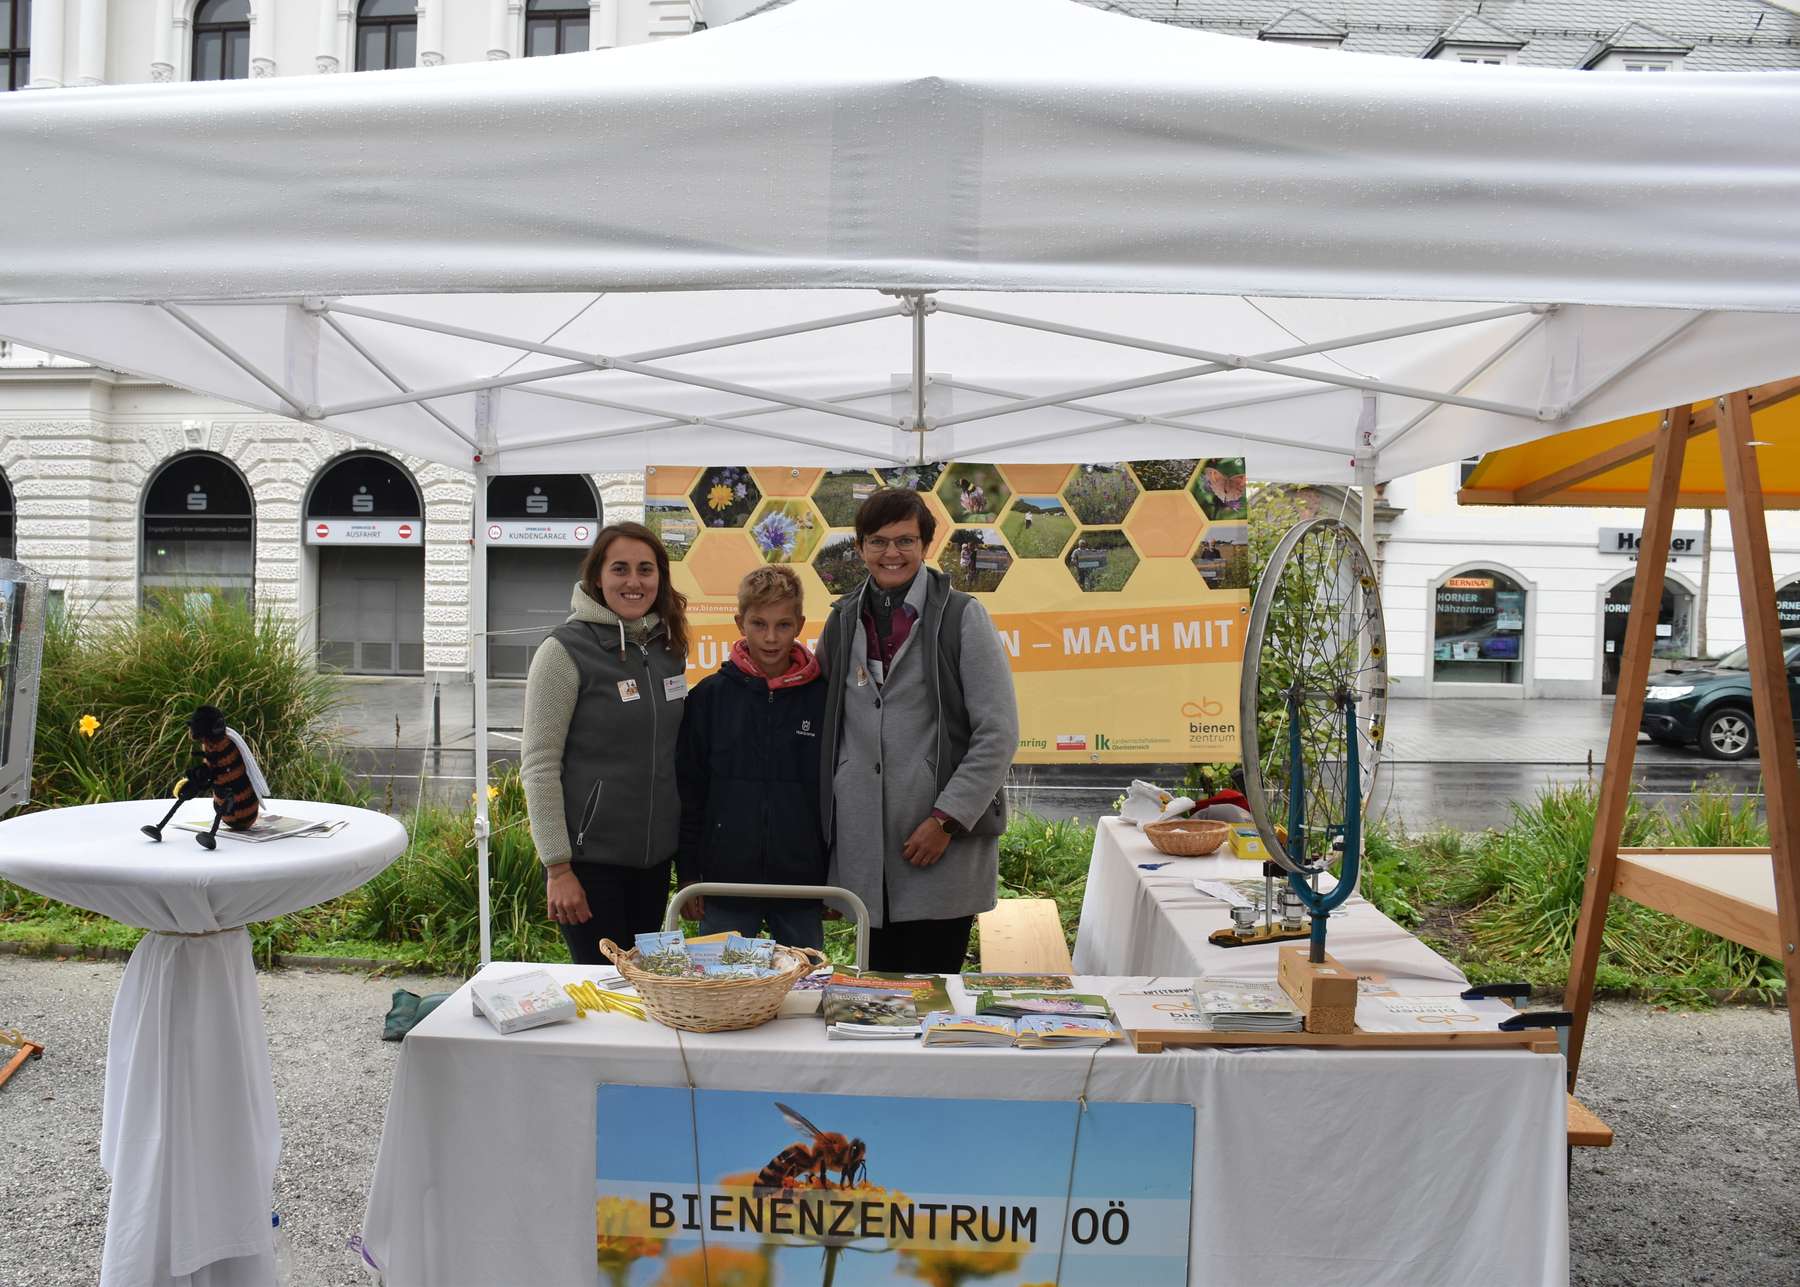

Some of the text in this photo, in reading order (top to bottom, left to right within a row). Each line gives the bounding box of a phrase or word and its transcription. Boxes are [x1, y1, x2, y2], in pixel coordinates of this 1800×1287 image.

[508, 532, 567, 540] KUNDENGARAGE
[1438, 593, 1478, 602] HORNER
[1437, 604, 1495, 614] Nähzentrum
[1062, 623, 1160, 656] MACH
[1173, 618, 1234, 650] MIT
[1190, 723, 1235, 733] bienen
[1190, 734, 1235, 743] zentrum
[649, 1192, 1130, 1246] BIENENZENTRUM OÖ
